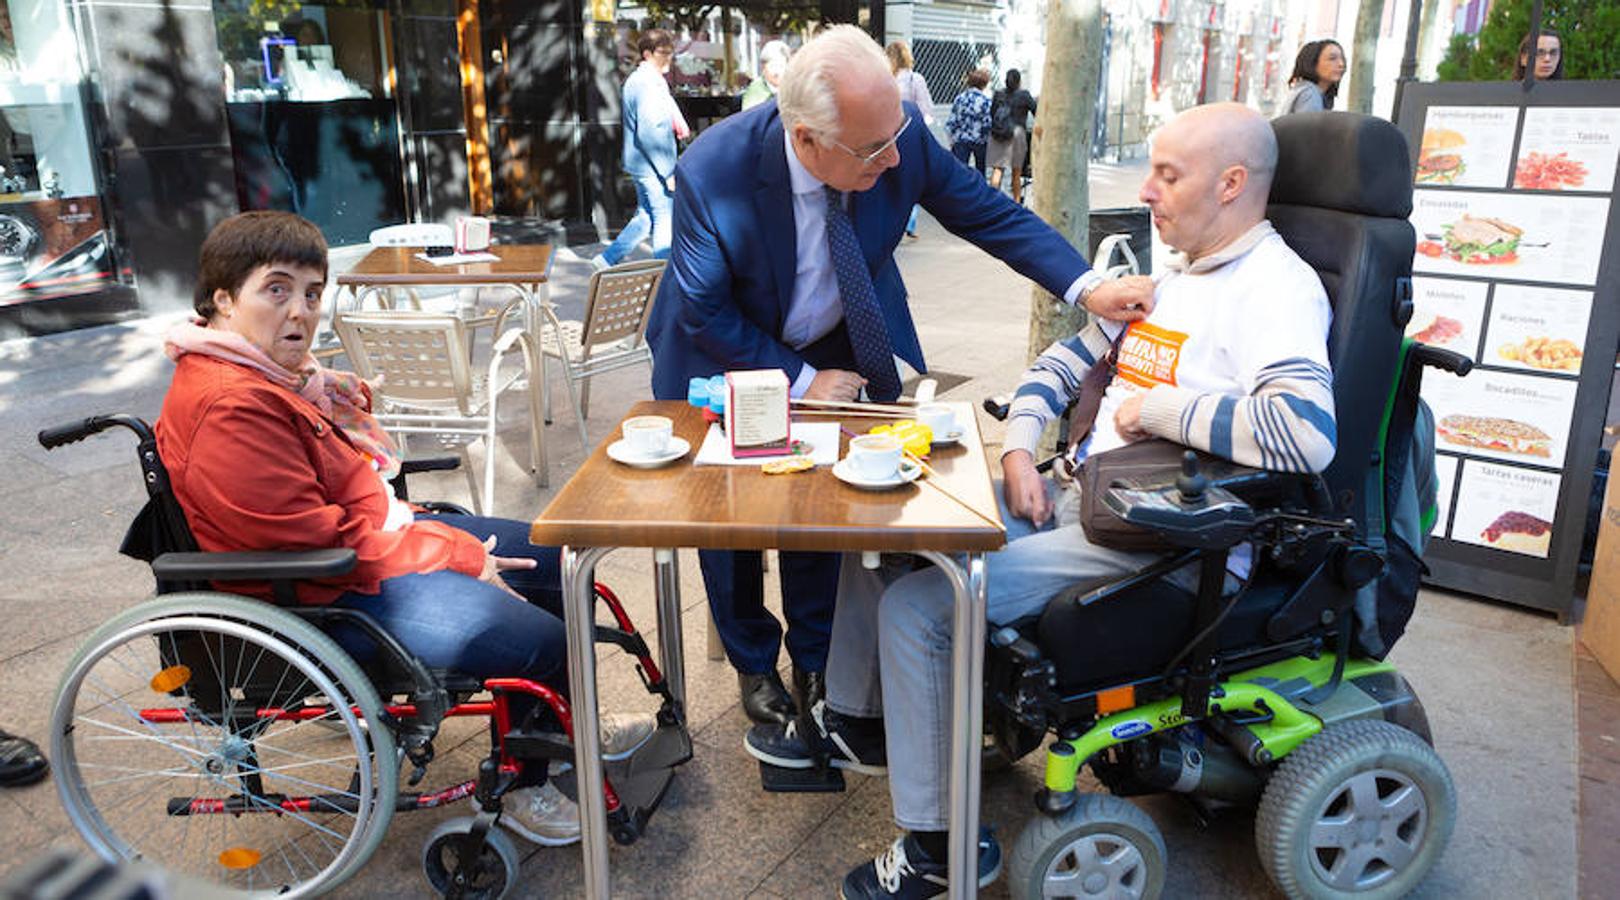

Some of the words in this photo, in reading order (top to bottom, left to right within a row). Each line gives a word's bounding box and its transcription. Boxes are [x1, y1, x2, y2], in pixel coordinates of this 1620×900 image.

[1500, 313, 1546, 326] Raciones
[1481, 466, 1512, 481] Tartas
[1514, 472, 1553, 487] caseras
